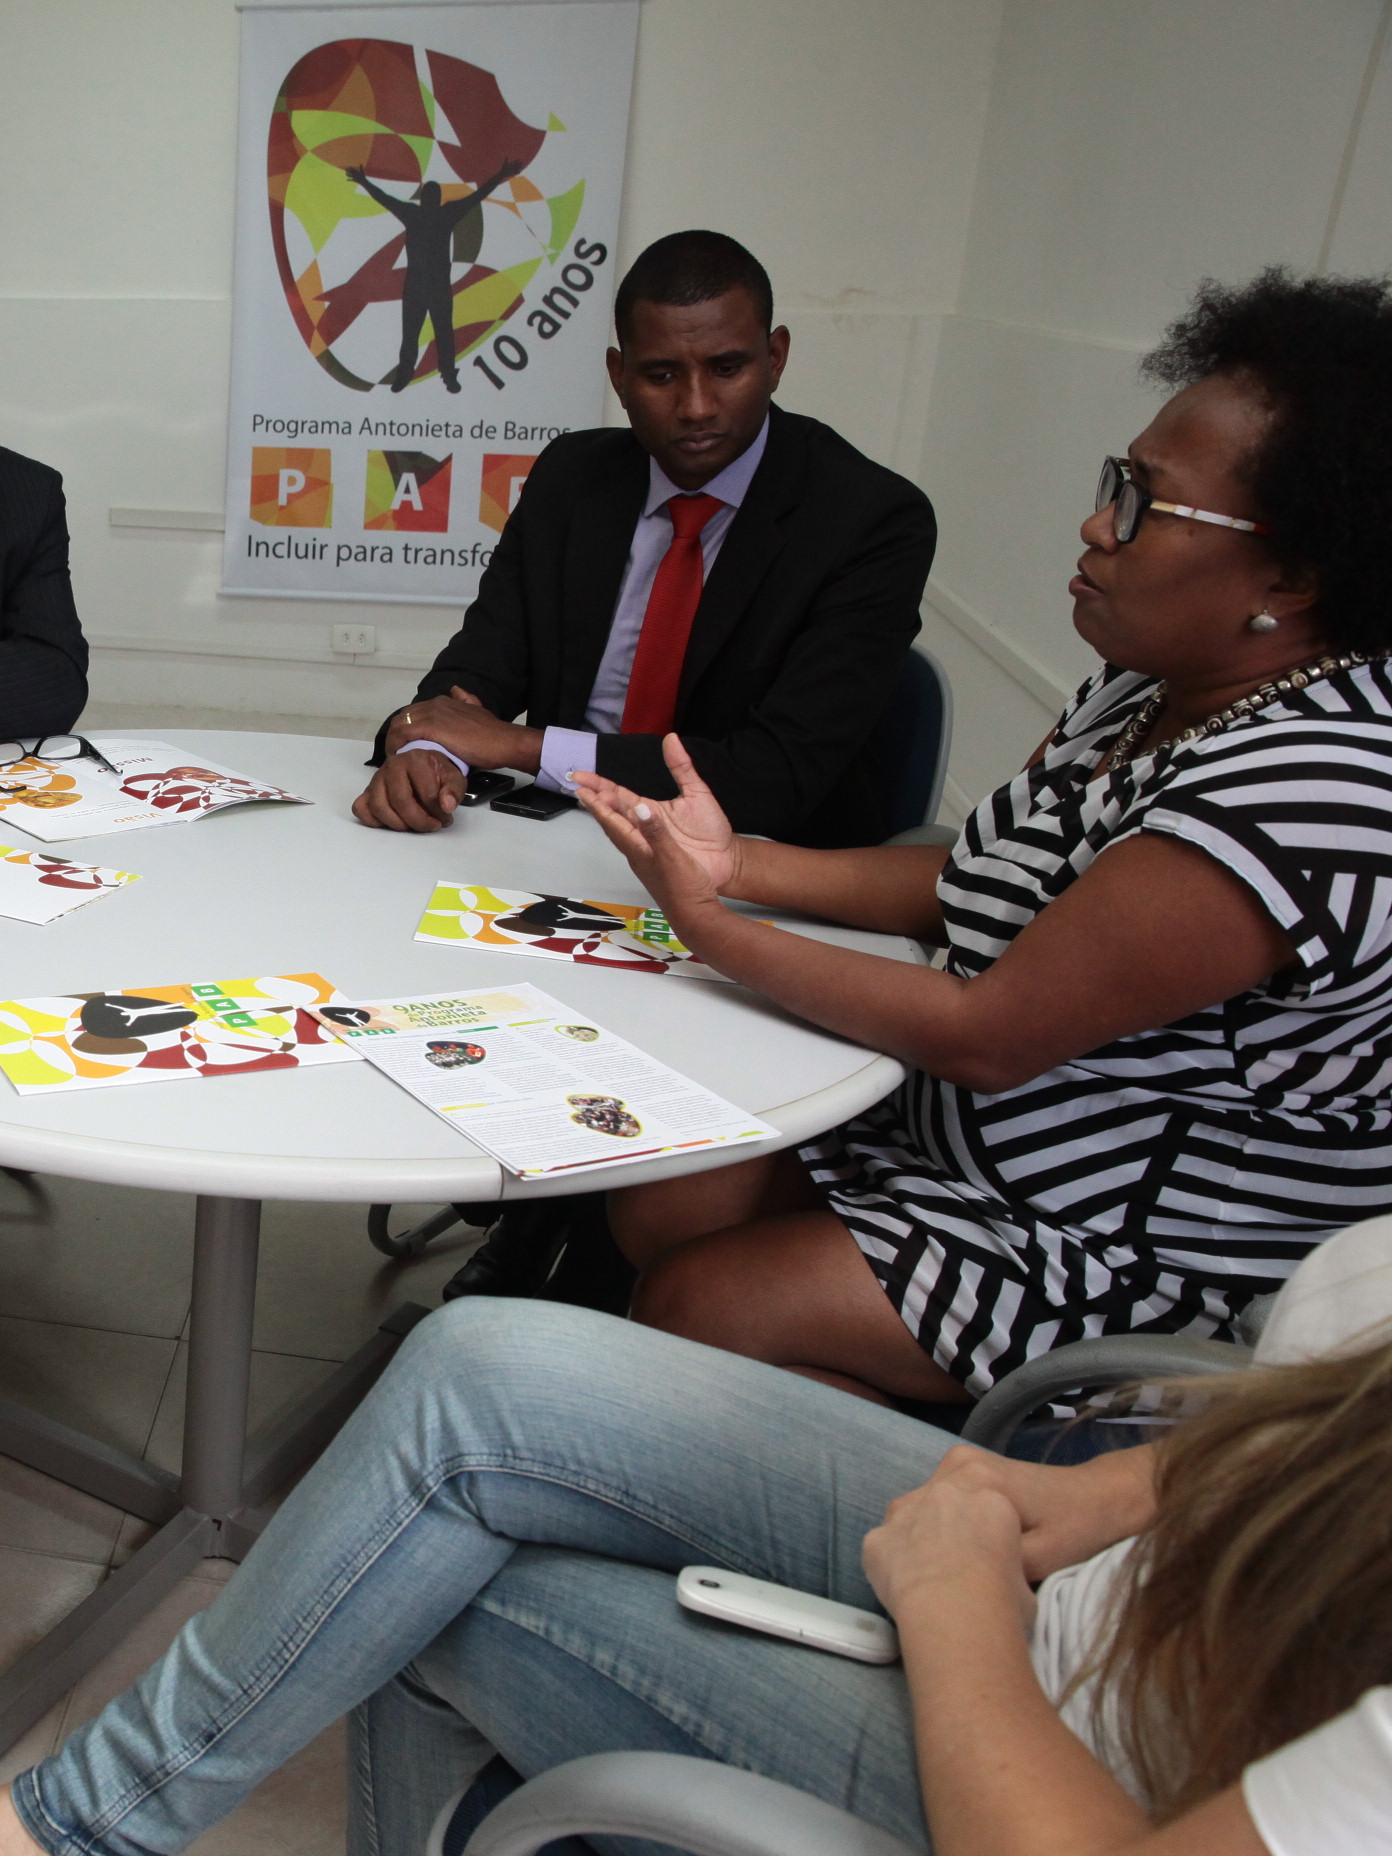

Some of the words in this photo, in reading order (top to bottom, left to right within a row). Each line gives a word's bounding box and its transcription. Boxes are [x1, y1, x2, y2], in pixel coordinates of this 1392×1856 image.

[472, 334, 529, 391] 10
[527, 237, 608, 340] anos
[252, 415, 352, 438] Programa
[359, 417, 463, 439] Antonieta
[470, 420, 497, 440] de
[248, 535, 328, 560] Incluir
[336, 544, 394, 567] para
[114, 811, 163, 824] Visão
[409, 1010, 487, 1022] Antonieta
[419, 1005, 483, 1017] Programa
[427, 1017, 480, 1027] Barros
